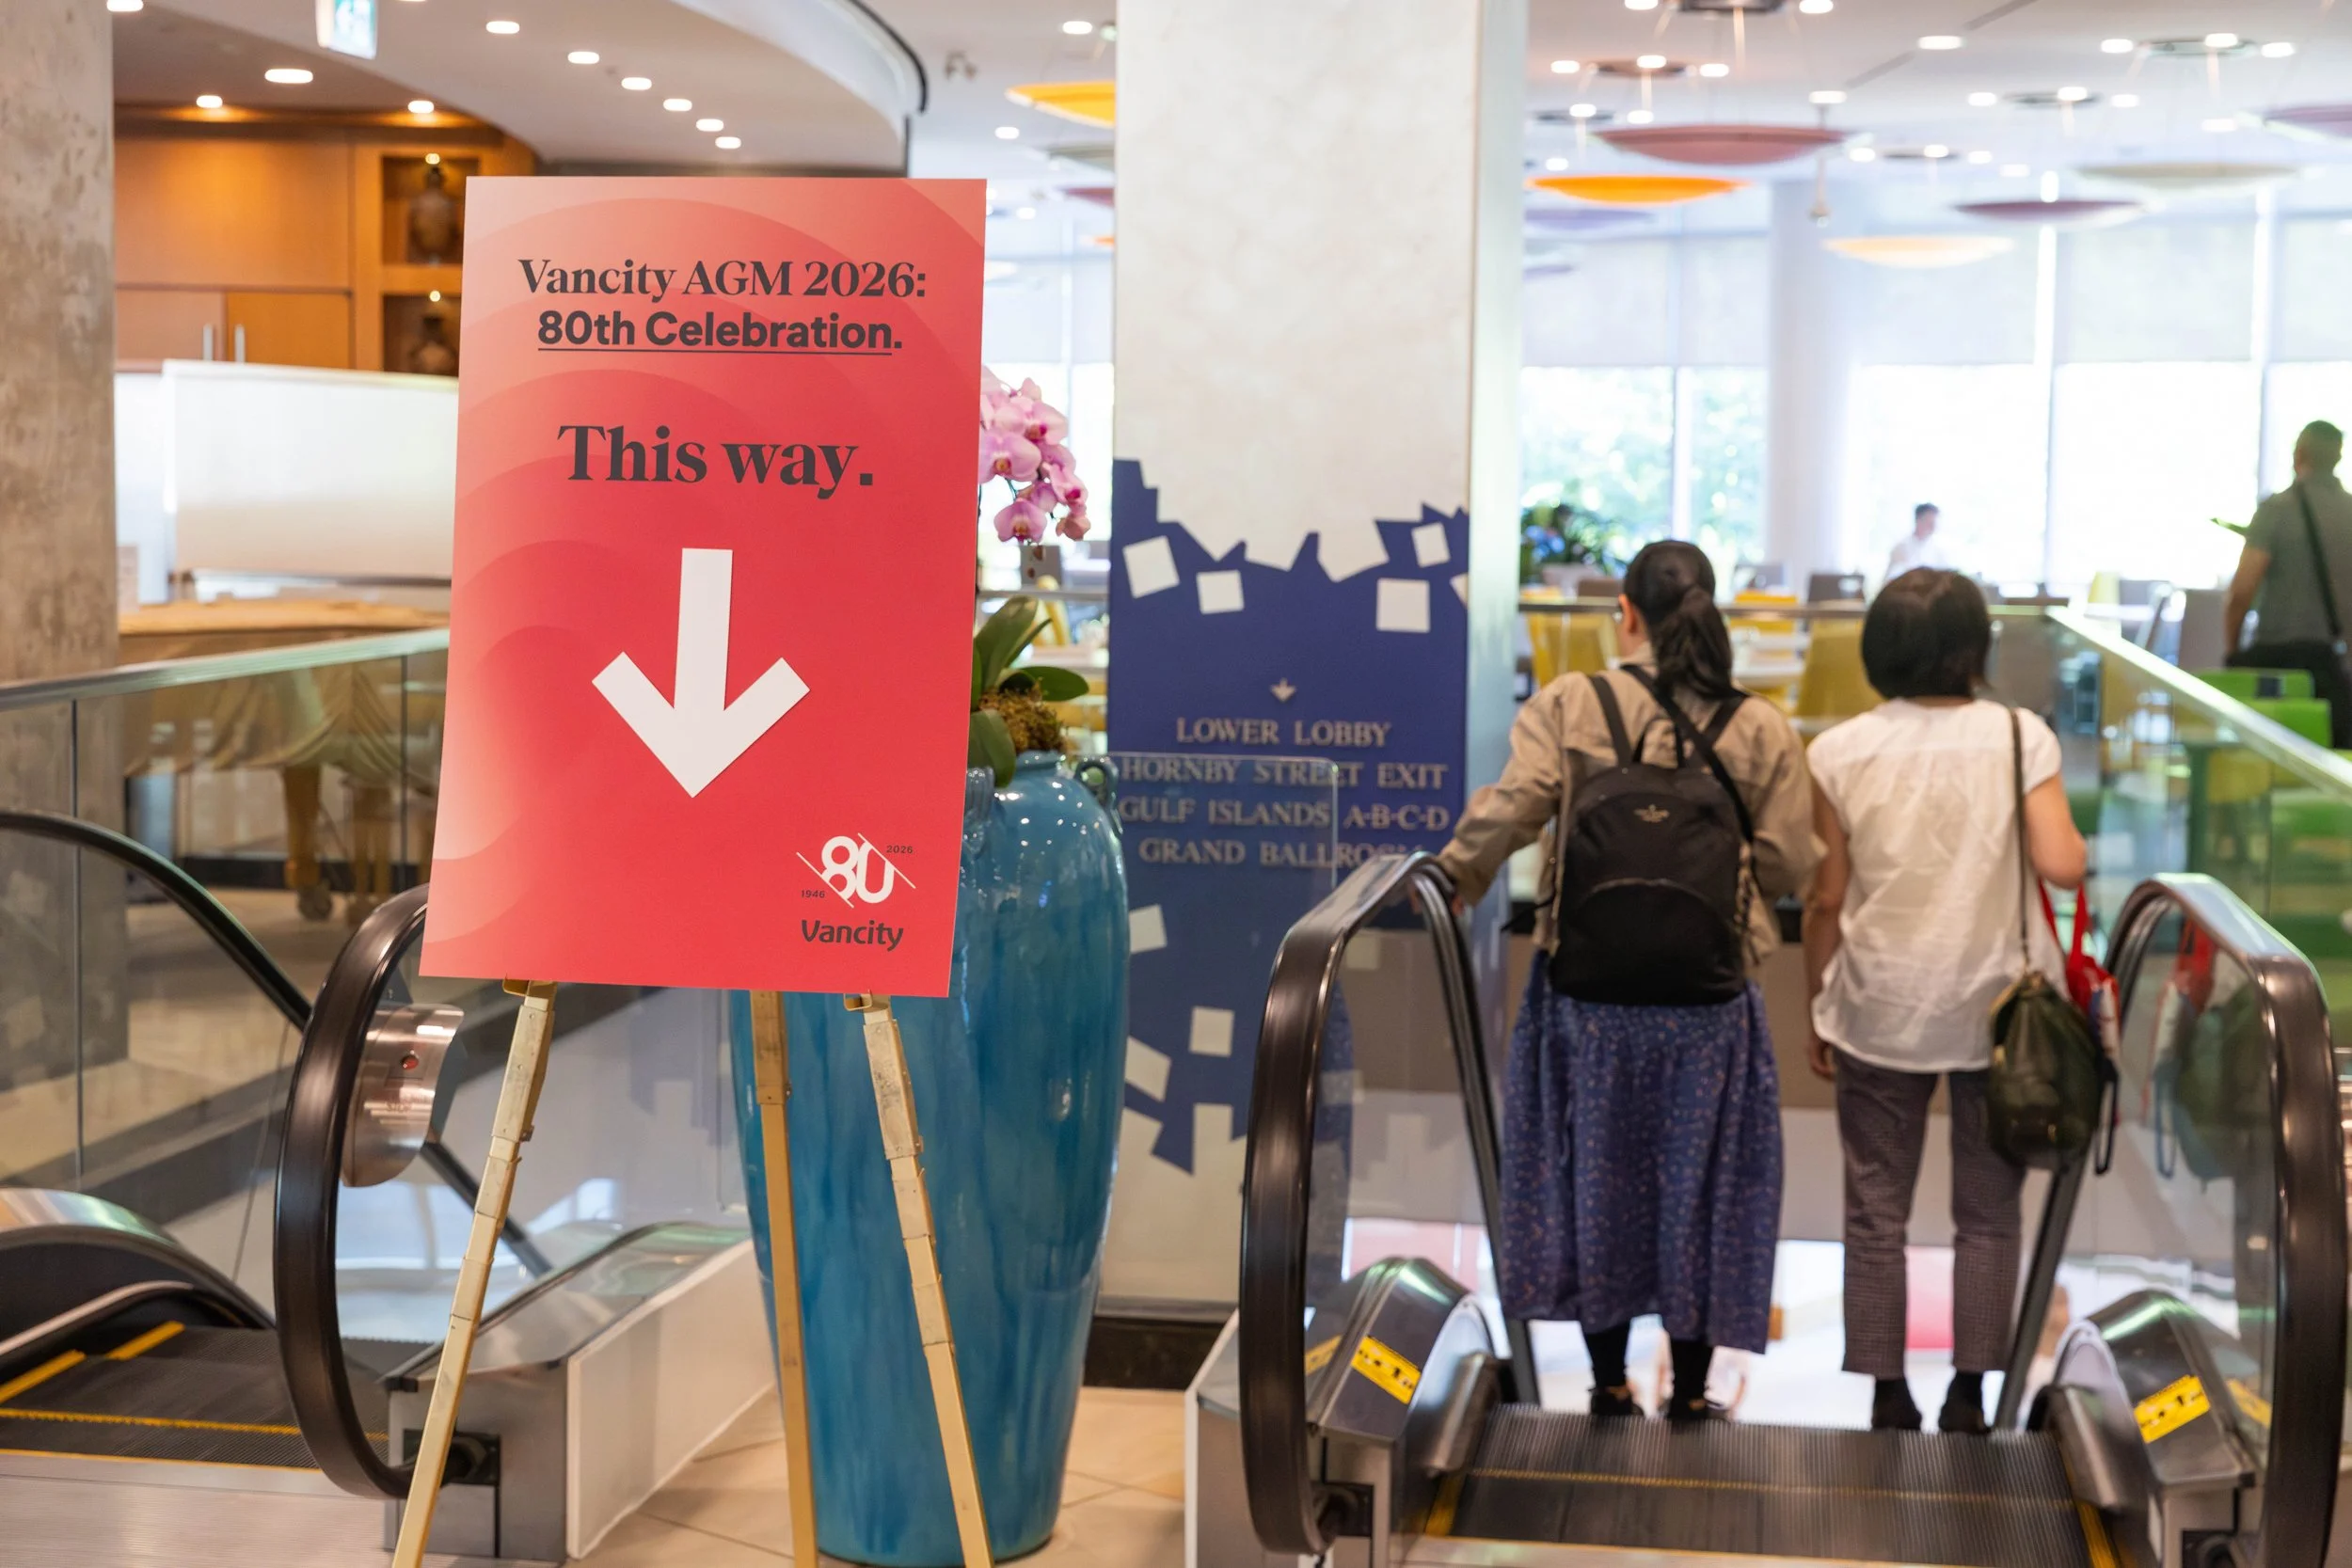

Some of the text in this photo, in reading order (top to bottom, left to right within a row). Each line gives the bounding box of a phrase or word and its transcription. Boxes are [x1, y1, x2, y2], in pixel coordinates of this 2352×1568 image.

[518, 259, 927, 303] Vancity AGM 2026:
[537, 310, 902, 349] 80th Celebration.
[557, 425, 873, 499] This way.
[1176, 717, 1391, 747] LOWER LOBBY
[1121, 755, 1449, 790] HORNBY STREET EXIT
[1119, 796, 1196, 823] GULF
[1208, 800, 1331, 827] ISLANDS
[886, 845, 914, 854] 2026
[1139, 836, 1246, 864] GRAND
[801, 889, 825, 898] 1946
[802, 919, 903, 952] Vancity
